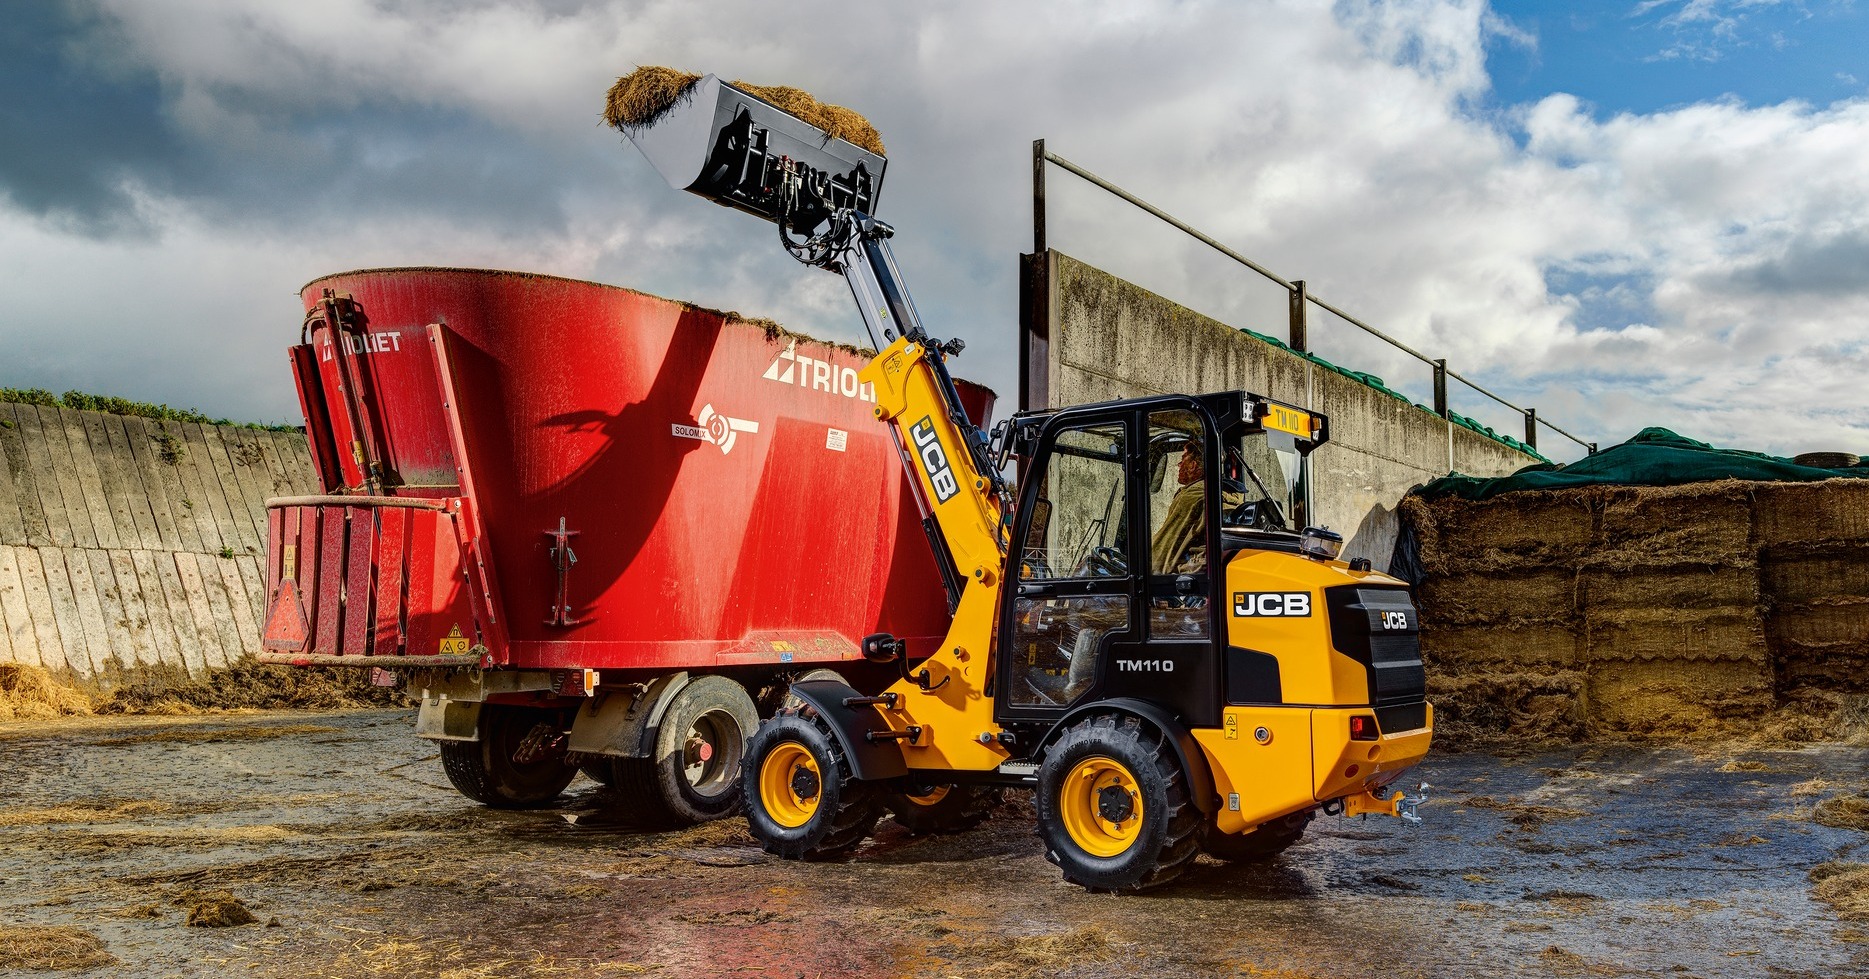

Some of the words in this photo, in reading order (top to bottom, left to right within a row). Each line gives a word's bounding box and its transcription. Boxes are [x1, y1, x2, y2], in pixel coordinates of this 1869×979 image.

[341, 332, 400, 355] IOLIET
[797, 355, 877, 403] TRIOLI
[1276, 409, 1287, 428] TM
[675, 426, 706, 438] SOLOMIX
[913, 425, 956, 500] JCB
[1236, 594, 1310, 615] JCB
[1383, 612, 1407, 629] JCB
[1117, 660, 1174, 671] TM110
[1060, 738, 1102, 759] EARTHMOVER
